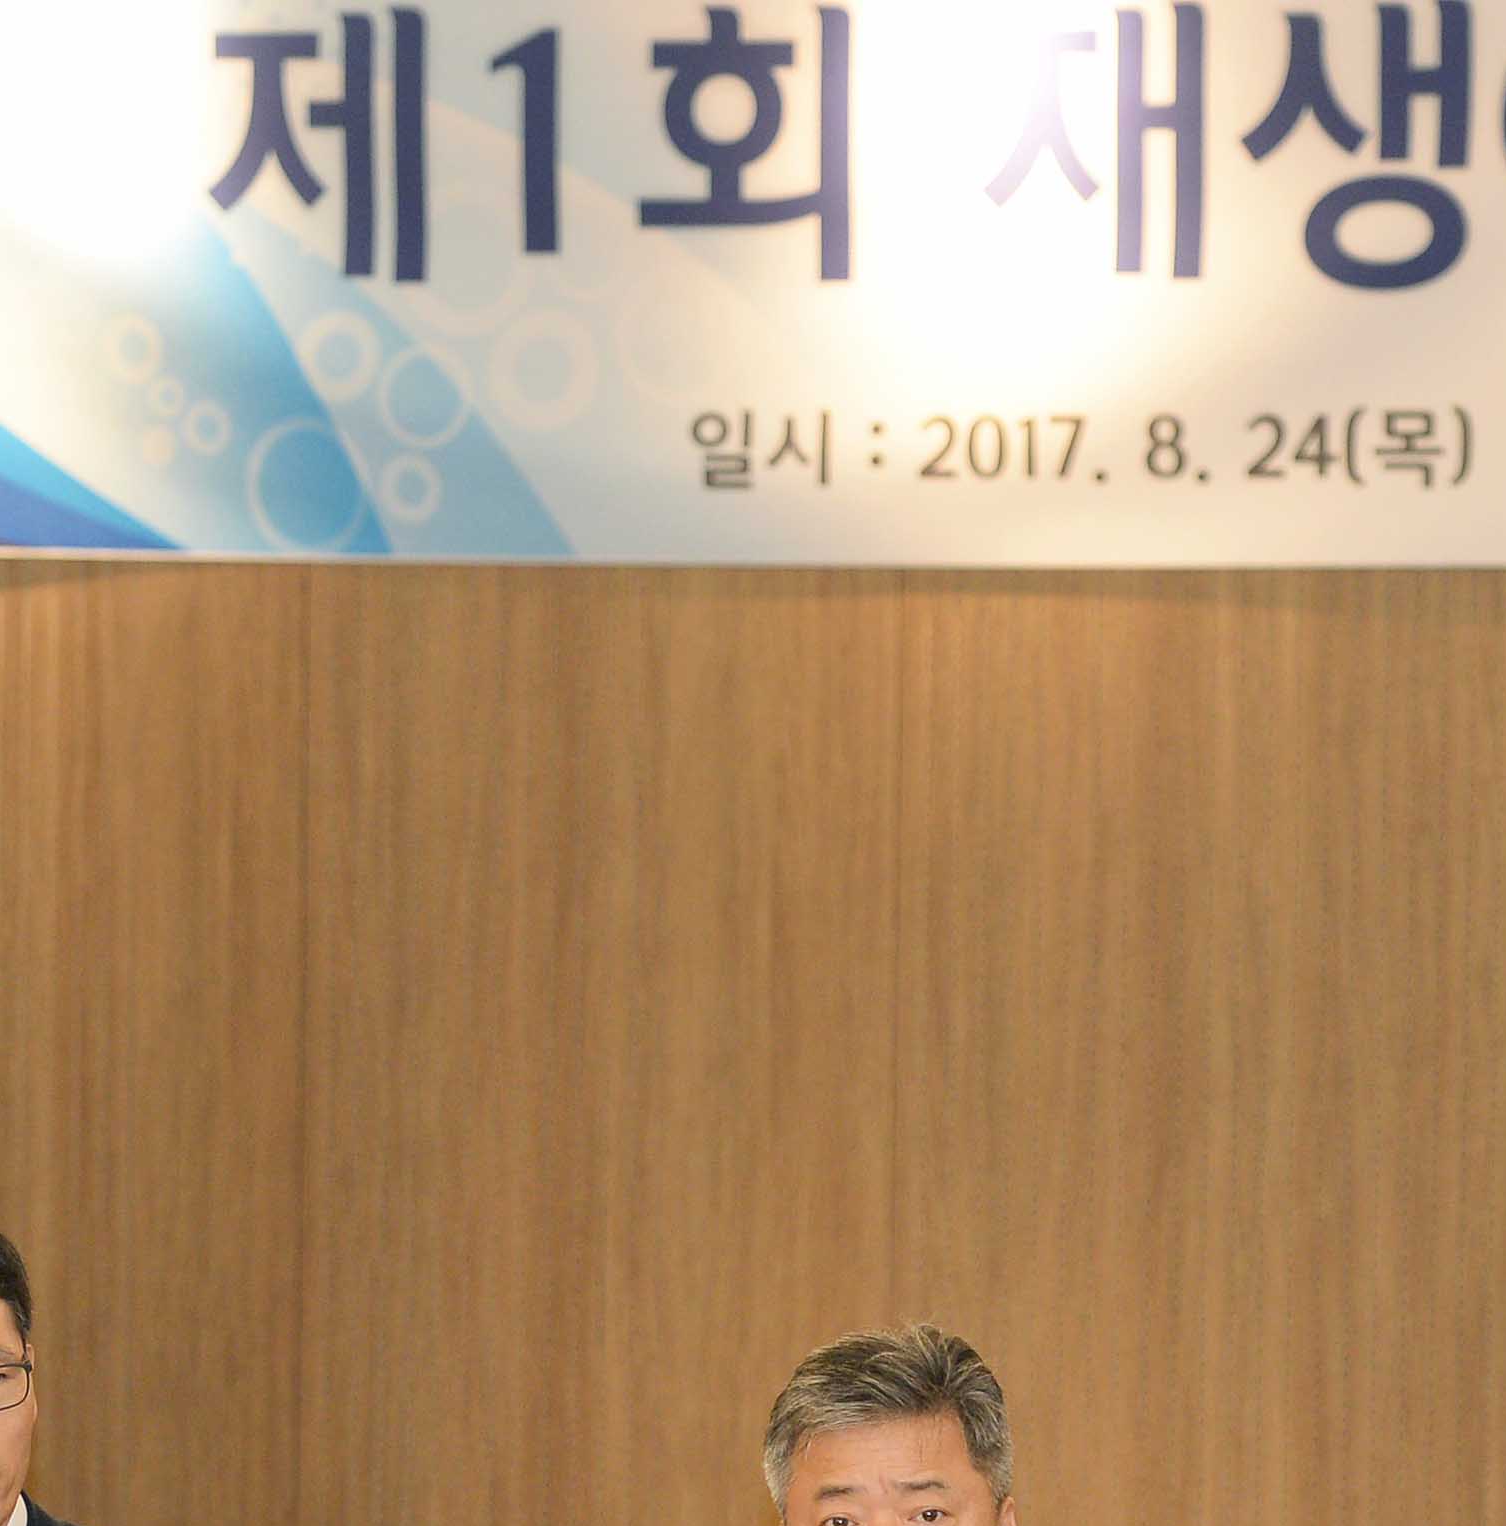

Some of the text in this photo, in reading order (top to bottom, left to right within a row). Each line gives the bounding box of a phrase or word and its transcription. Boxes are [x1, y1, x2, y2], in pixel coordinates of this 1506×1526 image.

[208, 2, 852, 282] 제1회
[690, 410, 832, 487] 일시
[920, 417, 1108, 484] 2017.
[1144, 417, 1211, 486] 8.
[1247, 407, 1474, 490] 24(목)
